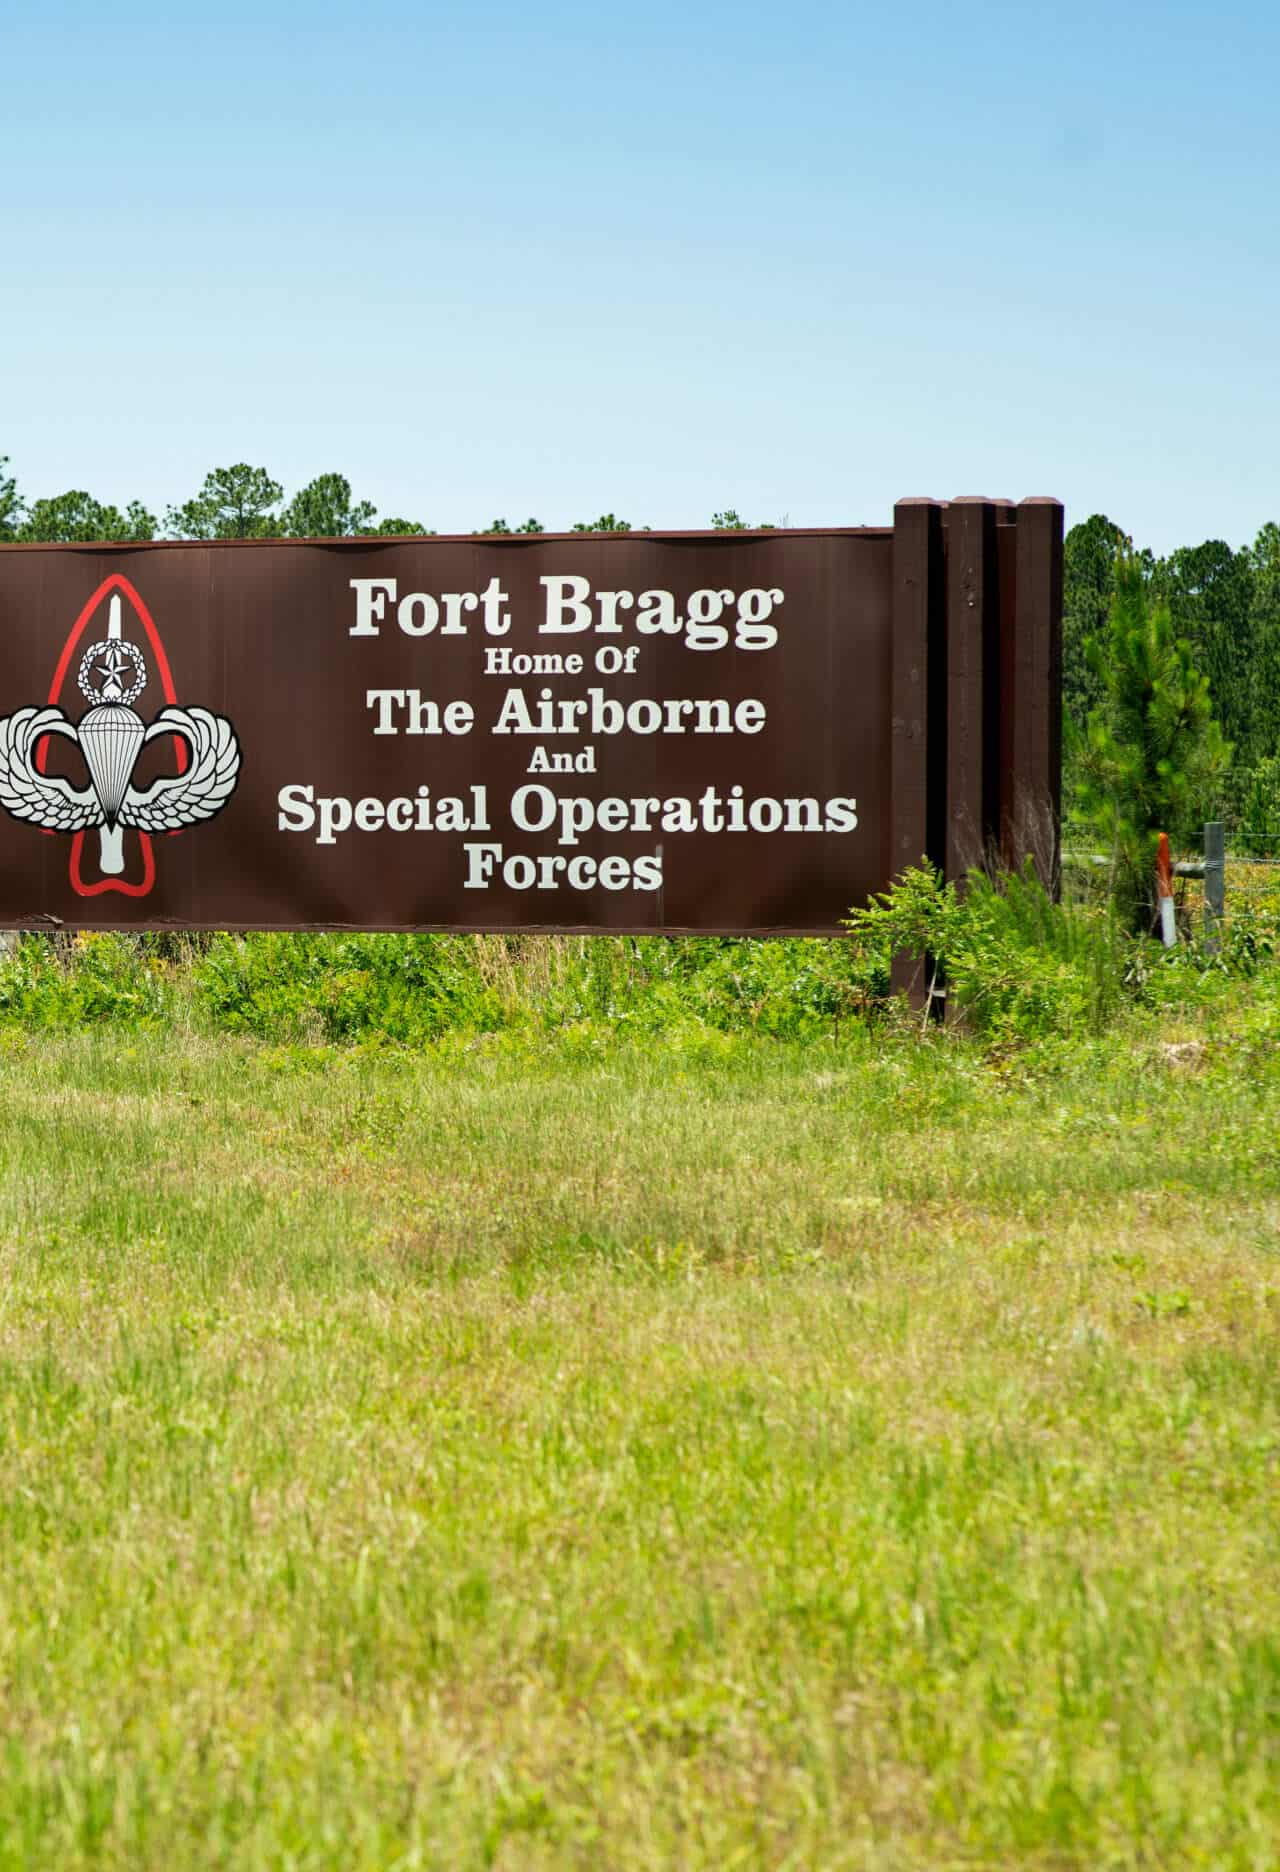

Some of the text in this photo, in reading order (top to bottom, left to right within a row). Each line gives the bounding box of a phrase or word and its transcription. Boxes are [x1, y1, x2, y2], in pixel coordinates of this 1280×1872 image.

[350, 576, 784, 651] Fort Bragg
[484, 646, 640, 674] Home Of
[367, 688, 765, 735] The Airborne
[527, 746, 596, 773] And
[278, 785, 857, 844] Special Operations
[464, 843, 662, 890] Forces
